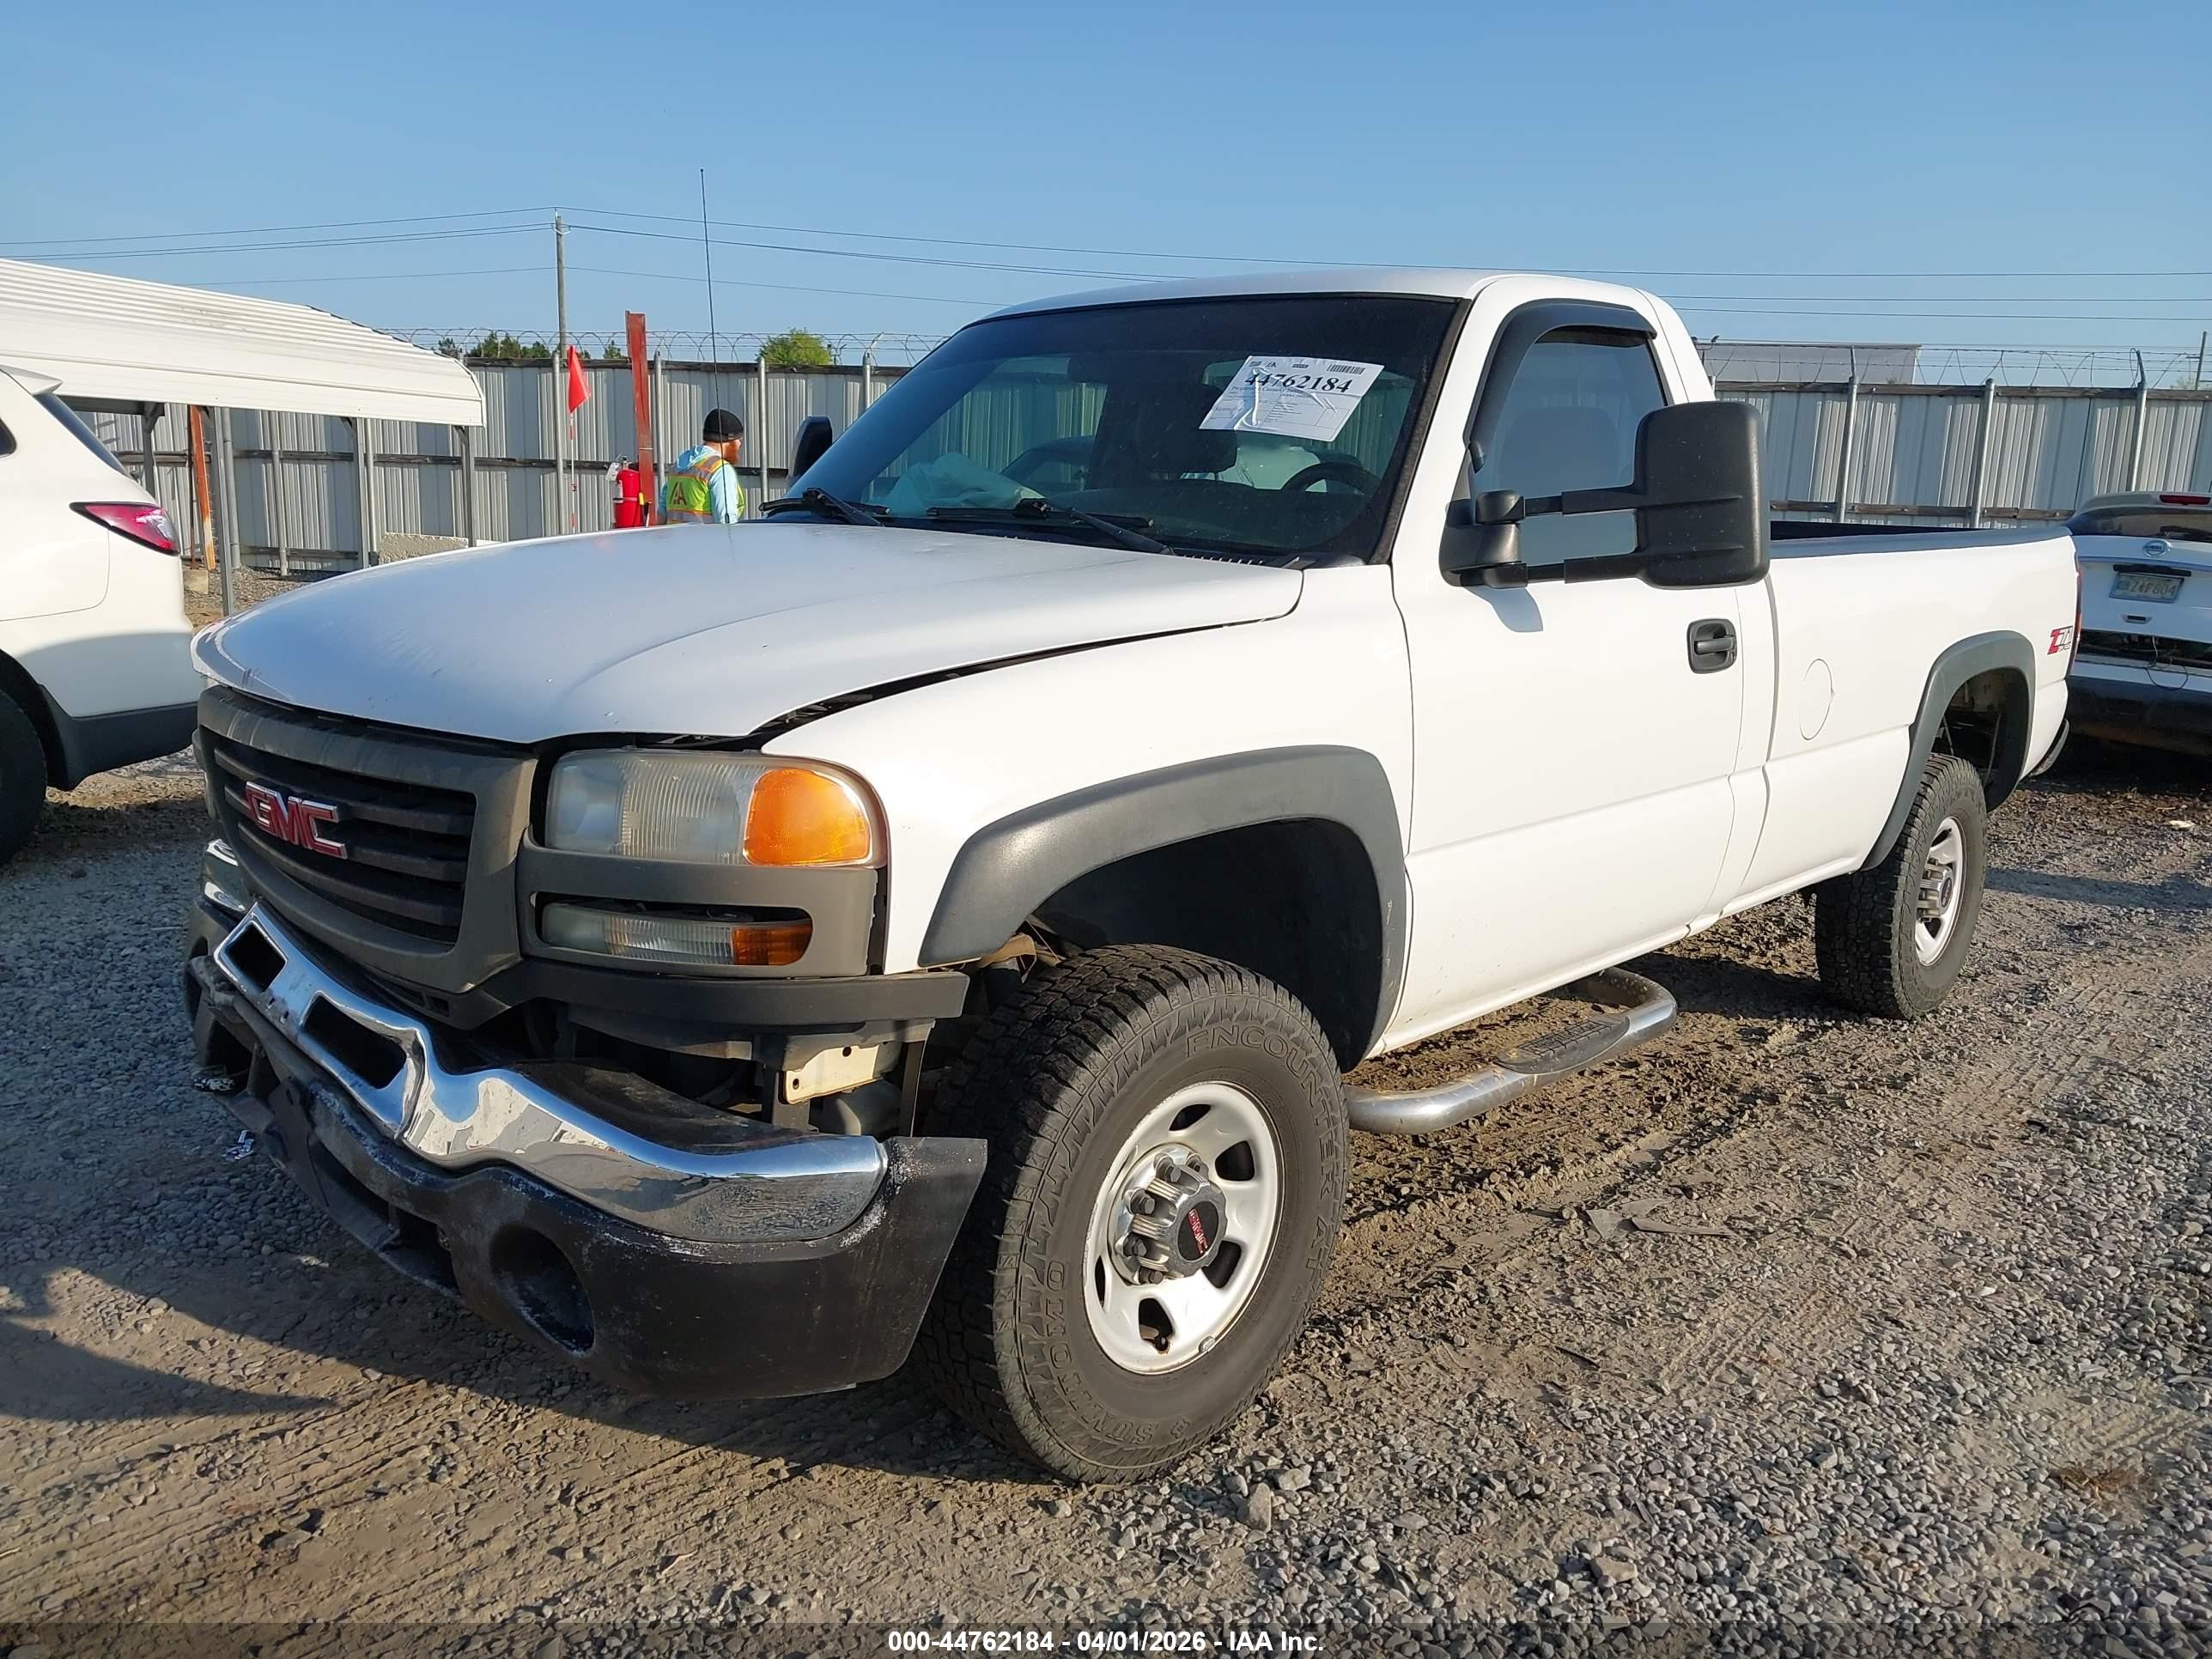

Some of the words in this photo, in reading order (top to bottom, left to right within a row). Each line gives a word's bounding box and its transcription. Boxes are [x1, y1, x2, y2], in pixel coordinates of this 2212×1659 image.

[1244, 372, 1353, 393] 44762184
[246, 781, 348, 860] GMC
[1187, 1024, 1337, 1201] ENCOUNTER
[1188, 1208, 1208, 1254] GMC
[1045, 1261, 1153, 1443] SUMITOMO
